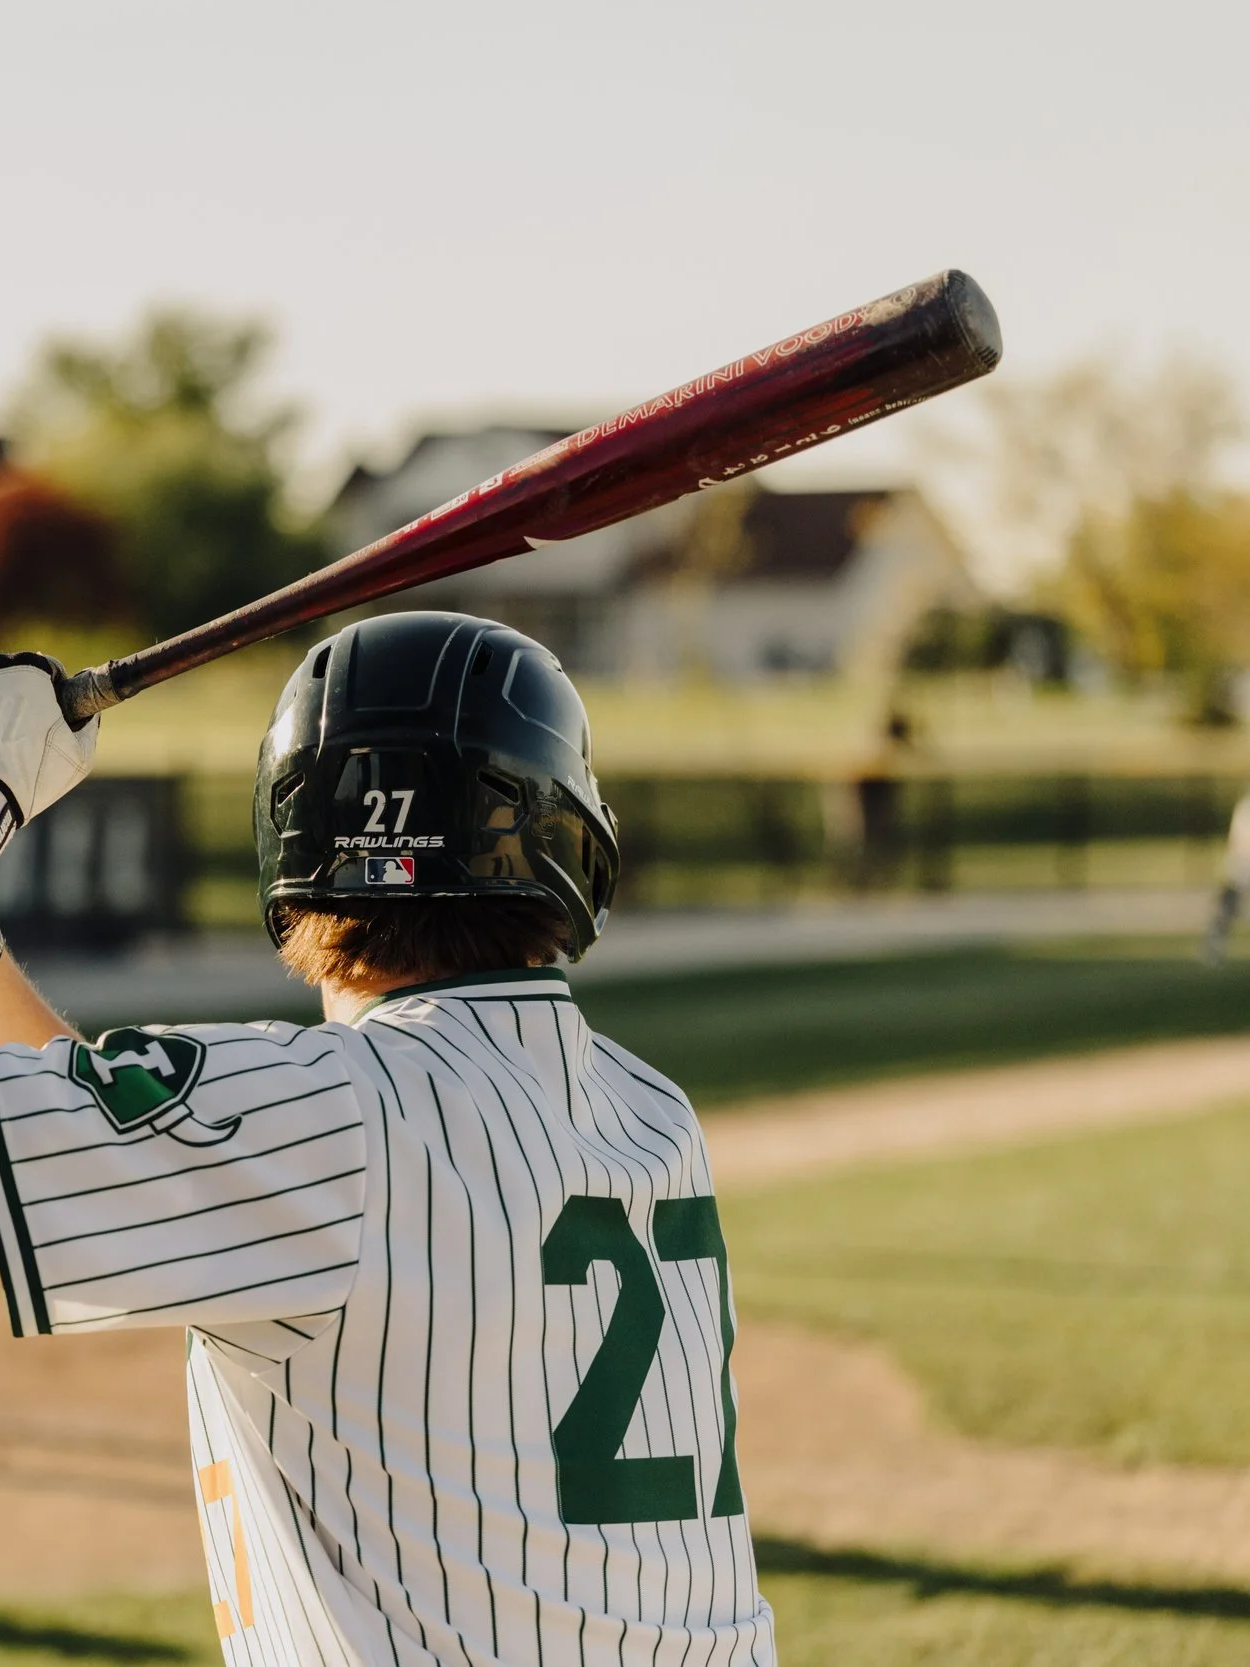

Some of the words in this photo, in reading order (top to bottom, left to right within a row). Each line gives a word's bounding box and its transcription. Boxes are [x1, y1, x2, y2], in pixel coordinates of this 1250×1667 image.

[577, 358, 745, 448] DEMARINI
[752, 285, 918, 367] VOODO
[333, 835, 446, 849] RAWLINGS
[363, 789, 415, 834] 27
[541, 1194, 745, 1525] 27
